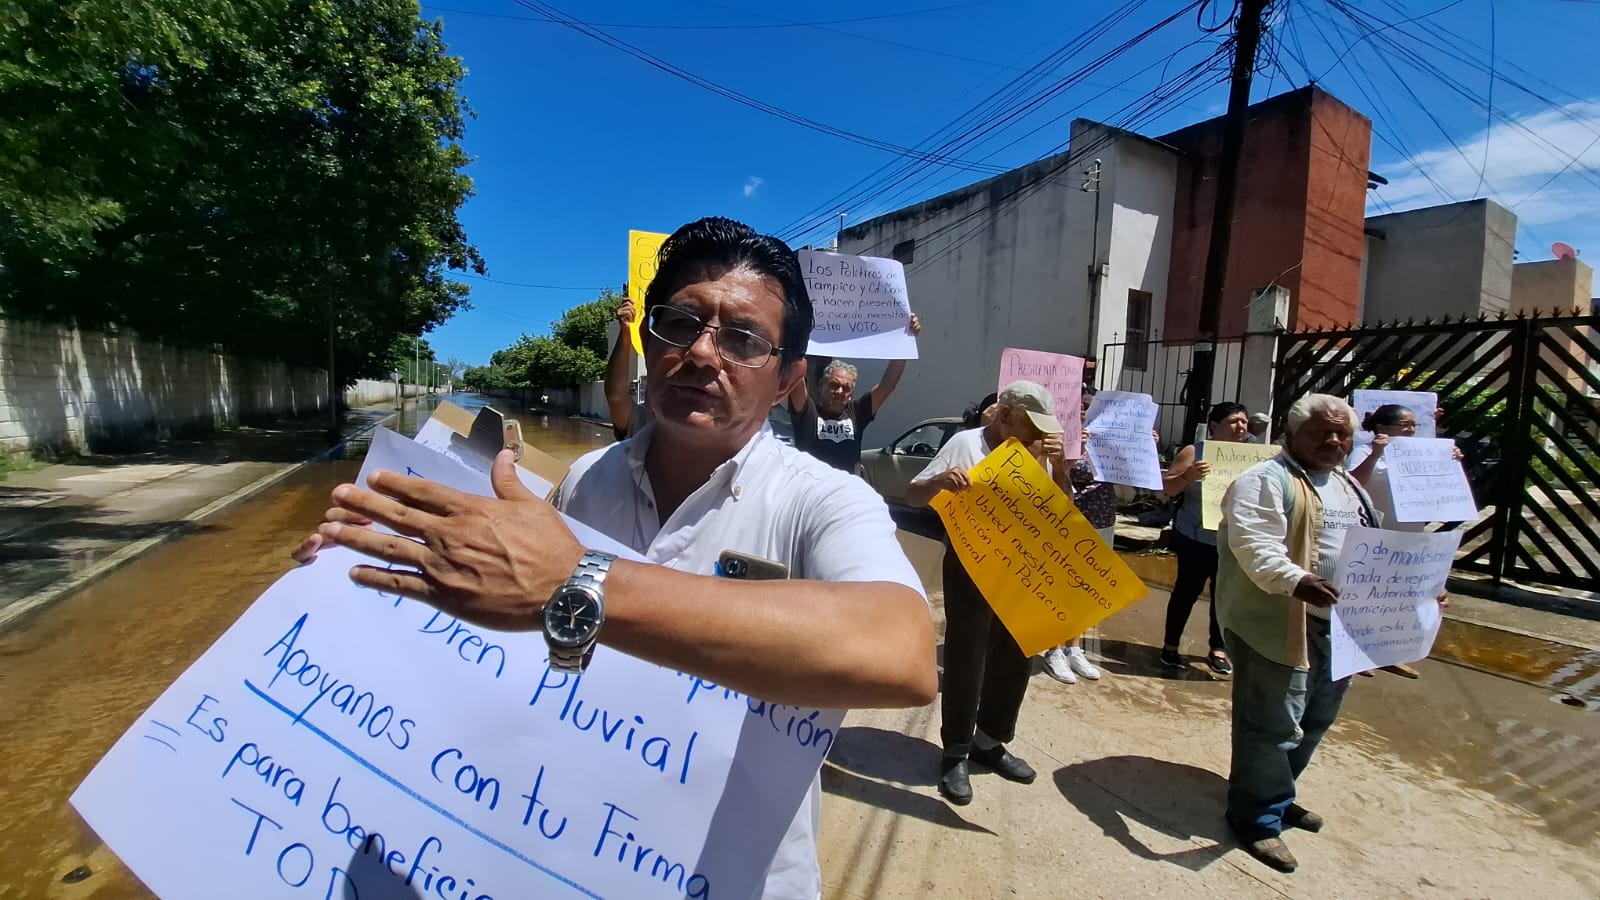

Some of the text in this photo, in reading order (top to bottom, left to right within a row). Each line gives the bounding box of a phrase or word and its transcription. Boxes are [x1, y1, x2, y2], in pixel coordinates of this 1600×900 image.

[809, 258, 832, 276] Los
[802, 278, 856, 294] Tampico
[860, 286, 866, 296] y
[823, 298, 854, 307] hacen
[828, 310, 862, 319] cuando
[1215, 446, 1274, 462] Autorida
[1001, 449, 1071, 540] Presidenta
[1074, 538, 1118, 588] Claudia
[1323, 508, 1357, 519] tandard
[976, 494, 1055, 586] Usted nuestra
[979, 466, 1041, 538] Sheinbaum
[1042, 541, 1113, 609] entregamos
[994, 548, 1012, 568] en
[1015, 563, 1067, 621] Palacio
[1346, 568, 1380, 585] nada
[1387, 570, 1402, 584] de
[1342, 602, 1416, 617] municipales
[418, 609, 698, 784] Dren Pluvial
[263, 612, 711, 900] Apoyanos con tu Firma
[186, 694, 494, 900] Es para benefici
